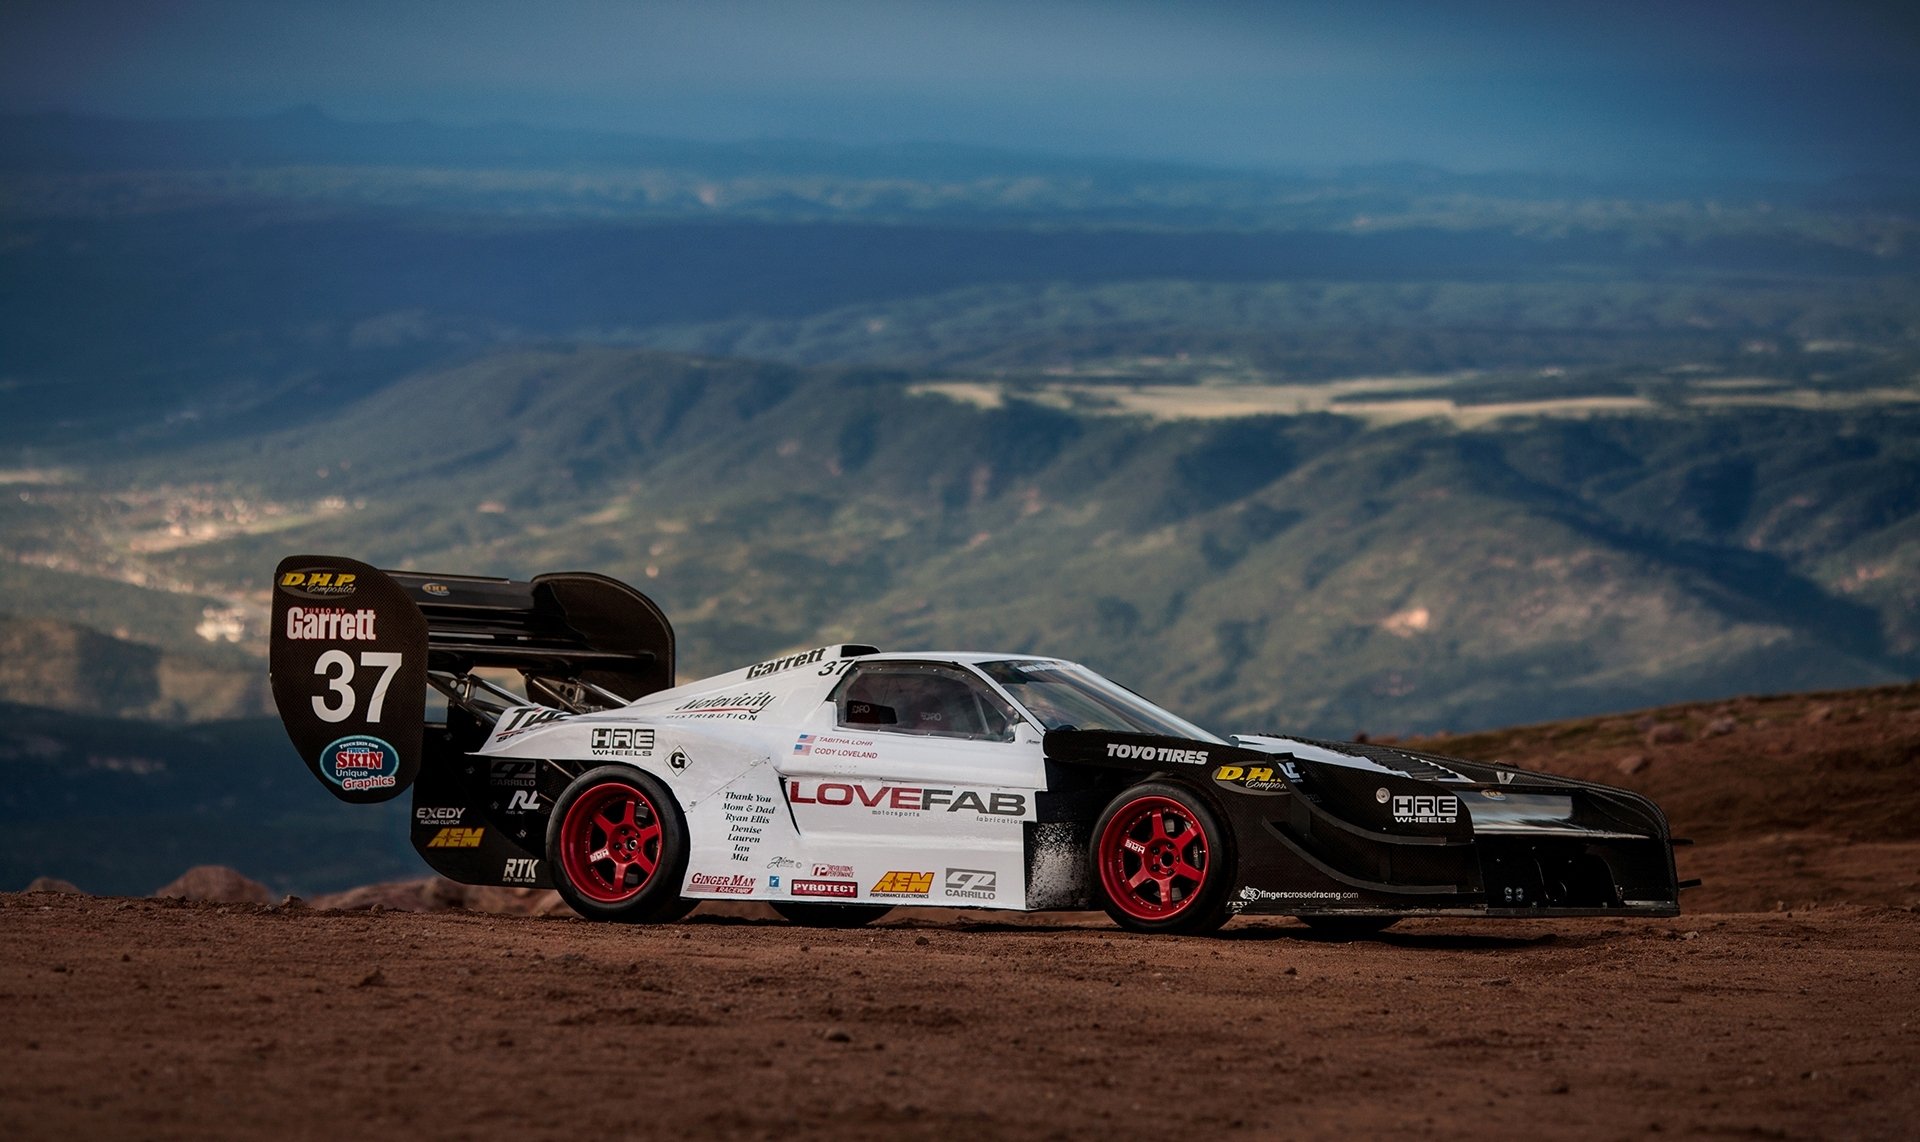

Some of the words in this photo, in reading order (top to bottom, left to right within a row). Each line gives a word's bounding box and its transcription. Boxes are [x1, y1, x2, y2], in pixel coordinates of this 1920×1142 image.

[306, 583, 356, 595] Composites
[304, 607, 331, 615] TURBO
[286, 606, 377, 641] Garrett
[746, 648, 826, 680] Garrett
[818, 659, 856, 677] 37
[311, 649, 403, 723] 37
[675, 691, 776, 714] Motovicity
[666, 713, 758, 721] DISTRIBUTION
[591, 728, 655, 749] HRE
[819, 736, 850, 745] TABITHA
[592, 749, 652, 757] WHEELS
[815, 747, 837, 757] CODY
[838, 749, 878, 760] LOVELAND
[335, 751, 383, 770] SKIN
[670, 751, 686, 770] G
[336, 769, 369, 778] Unique
[342, 775, 396, 791] Graphics
[490, 779, 536, 788] CARRILLO
[725, 791, 754, 802] Thank
[755, 794, 772, 803] You
[789, 781, 1027, 817] LOVEFAB
[722, 802, 744, 812] Mom
[746, 804, 754, 812] &
[755, 805, 776, 815] Dad
[1393, 795, 1458, 817] HRE
[416, 806, 466, 820] EXEDY
[725, 813, 749, 824] Ryan
[750, 815, 770, 825] Ellis
[872, 810, 920, 818] motorsports
[976, 815, 1024, 825] fabrication
[731, 824, 762, 835] Denise
[427, 828, 485, 848] AEM
[727, 833, 761, 844] Lauren
[734, 843, 750, 853] Ian
[731, 852, 749, 863] Mia
[503, 858, 539, 878] RTK
[691, 872, 729, 886] GINGER
[871, 871, 935, 893] AEM
[793, 883, 856, 893] PYROTECT
[945, 889, 996, 900] CARRILLO
[1260, 889, 1359, 901] fingerscrossedracing.com
